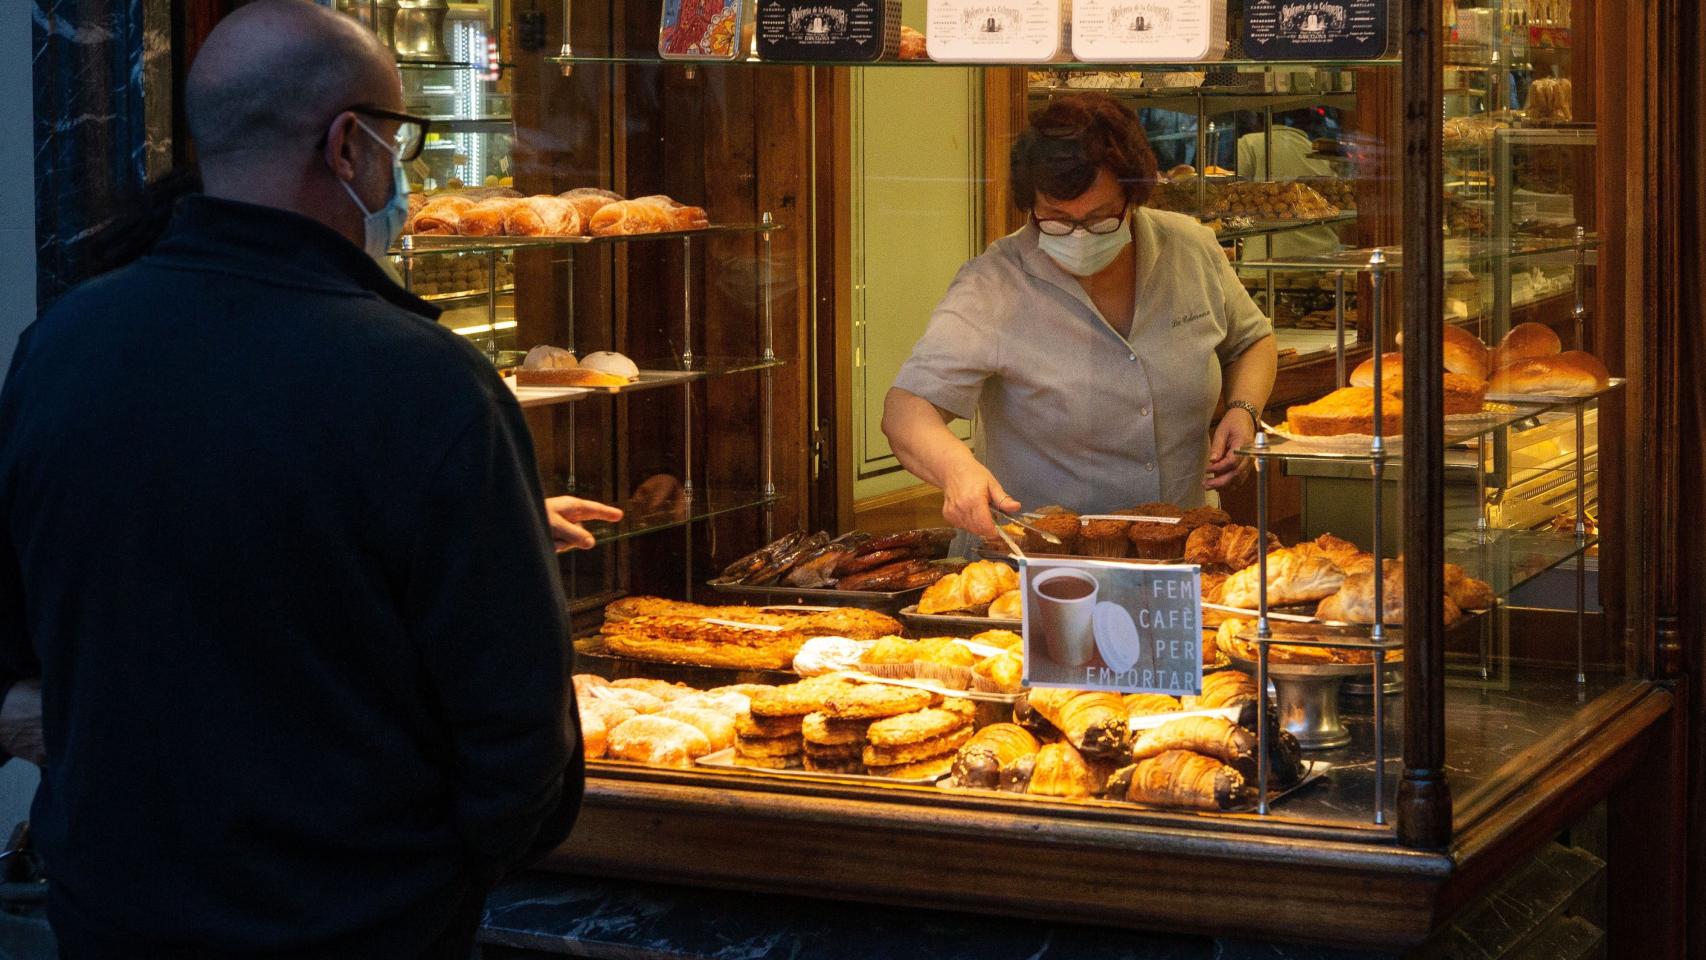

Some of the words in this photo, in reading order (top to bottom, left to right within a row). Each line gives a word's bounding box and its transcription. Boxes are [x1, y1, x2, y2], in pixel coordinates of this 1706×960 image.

[1153, 579, 1193, 599] FEM
[1139, 607, 1194, 630] CAFÈ
[1156, 640, 1195, 660] PER
[1086, 666, 1195, 691] EMPORTAR
